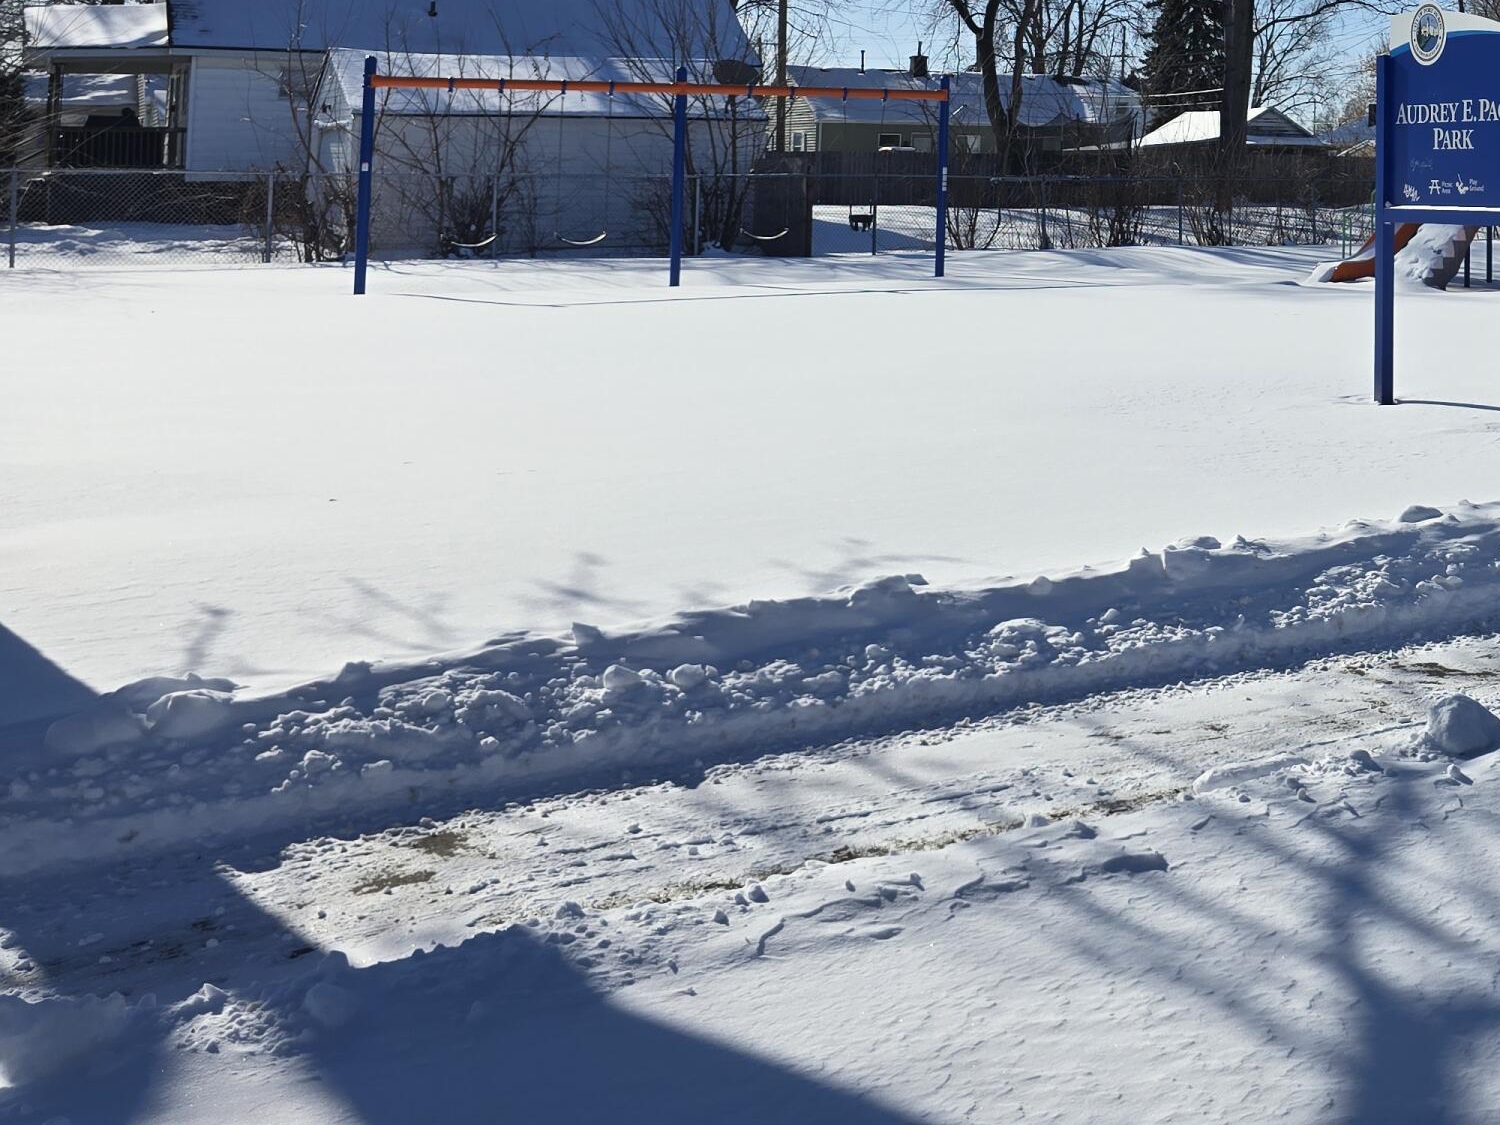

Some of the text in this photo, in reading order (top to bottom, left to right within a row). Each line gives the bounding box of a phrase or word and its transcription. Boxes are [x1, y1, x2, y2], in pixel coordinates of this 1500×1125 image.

[1396, 103, 1459, 124] AUDREY
[1461, 99, 1477, 122] E.
[1432, 127, 1474, 150] PARK
